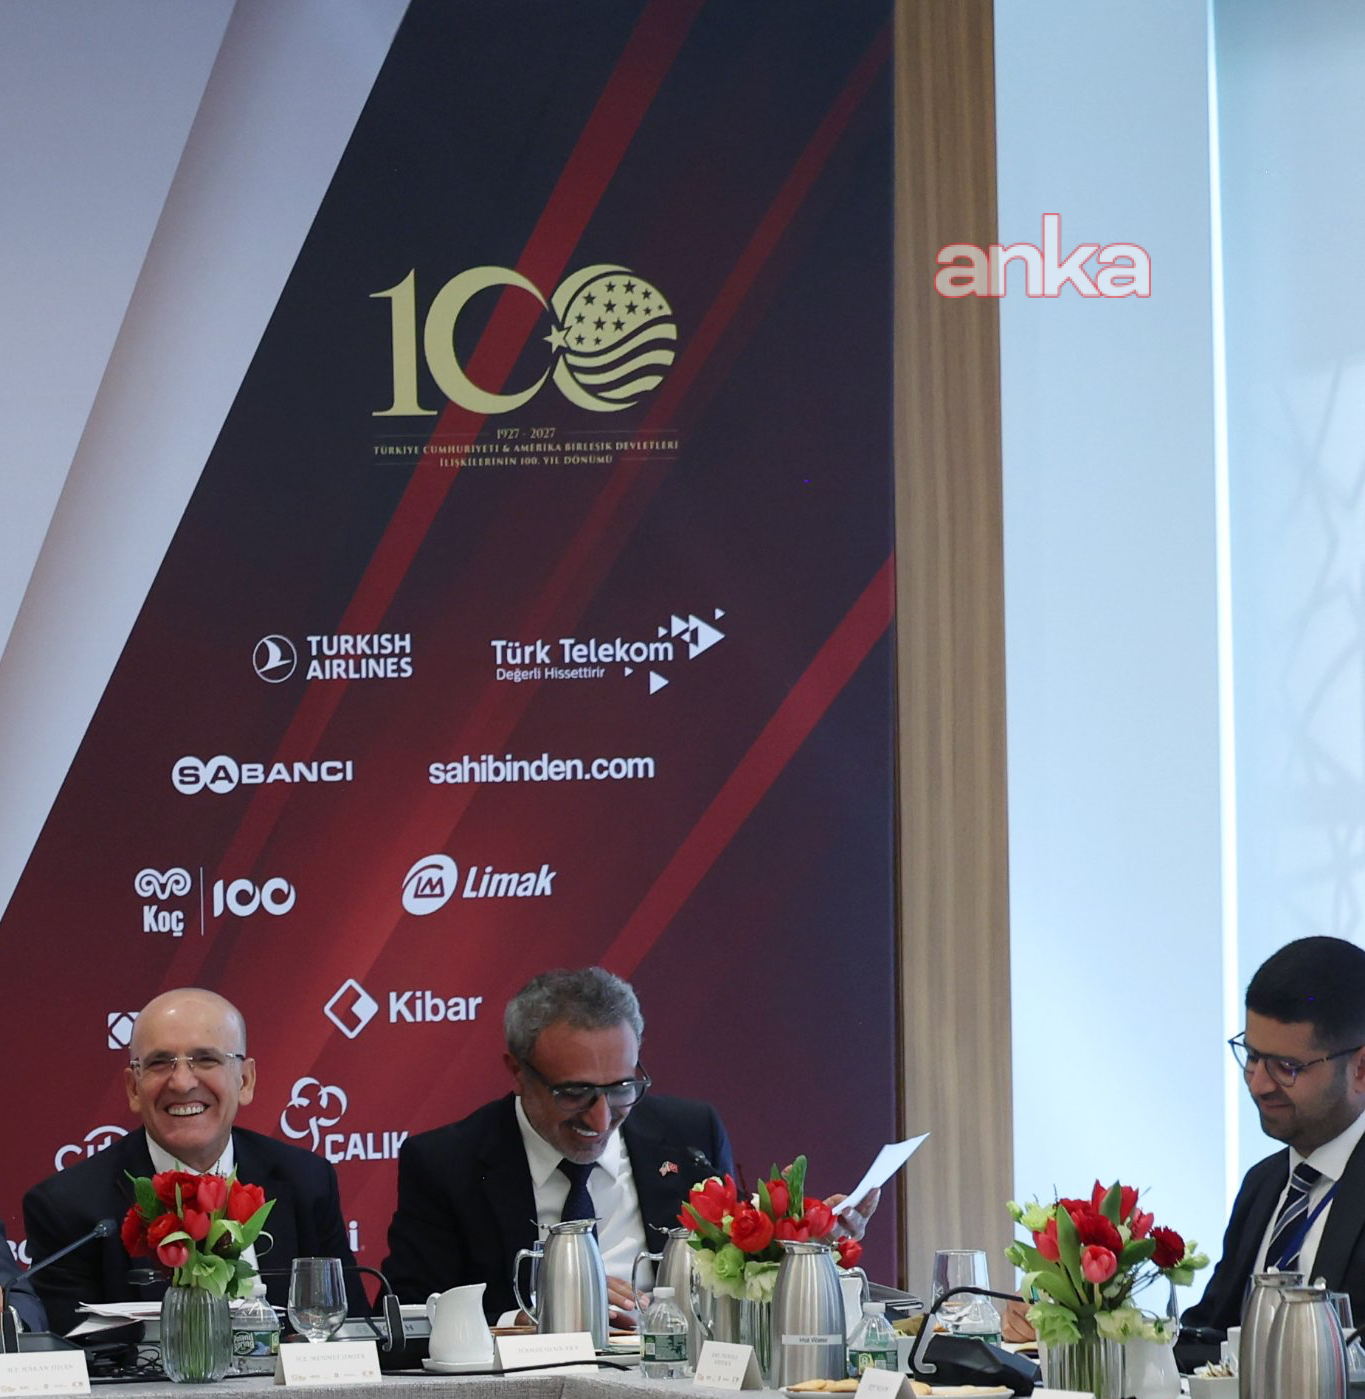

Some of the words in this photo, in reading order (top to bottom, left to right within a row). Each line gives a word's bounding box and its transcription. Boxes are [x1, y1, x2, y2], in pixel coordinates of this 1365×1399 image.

[496, 428, 520, 440] 1927
[530, 427, 556, 439] 2027
[306, 633, 412, 656] TURKISH
[490, 639, 551, 665] Türk
[559, 637, 674, 663] Telekom
[305, 656, 413, 681] AIRLINES
[496, 667, 541, 683] Değerli
[545, 666, 606, 680] Hissettirir
[173, 757, 354, 790] SABANCI
[428, 754, 656, 785] sahibinden.com
[462, 864, 557, 898] Limak
[142, 905, 185, 938] Koç
[388, 991, 483, 1023] Kibar
